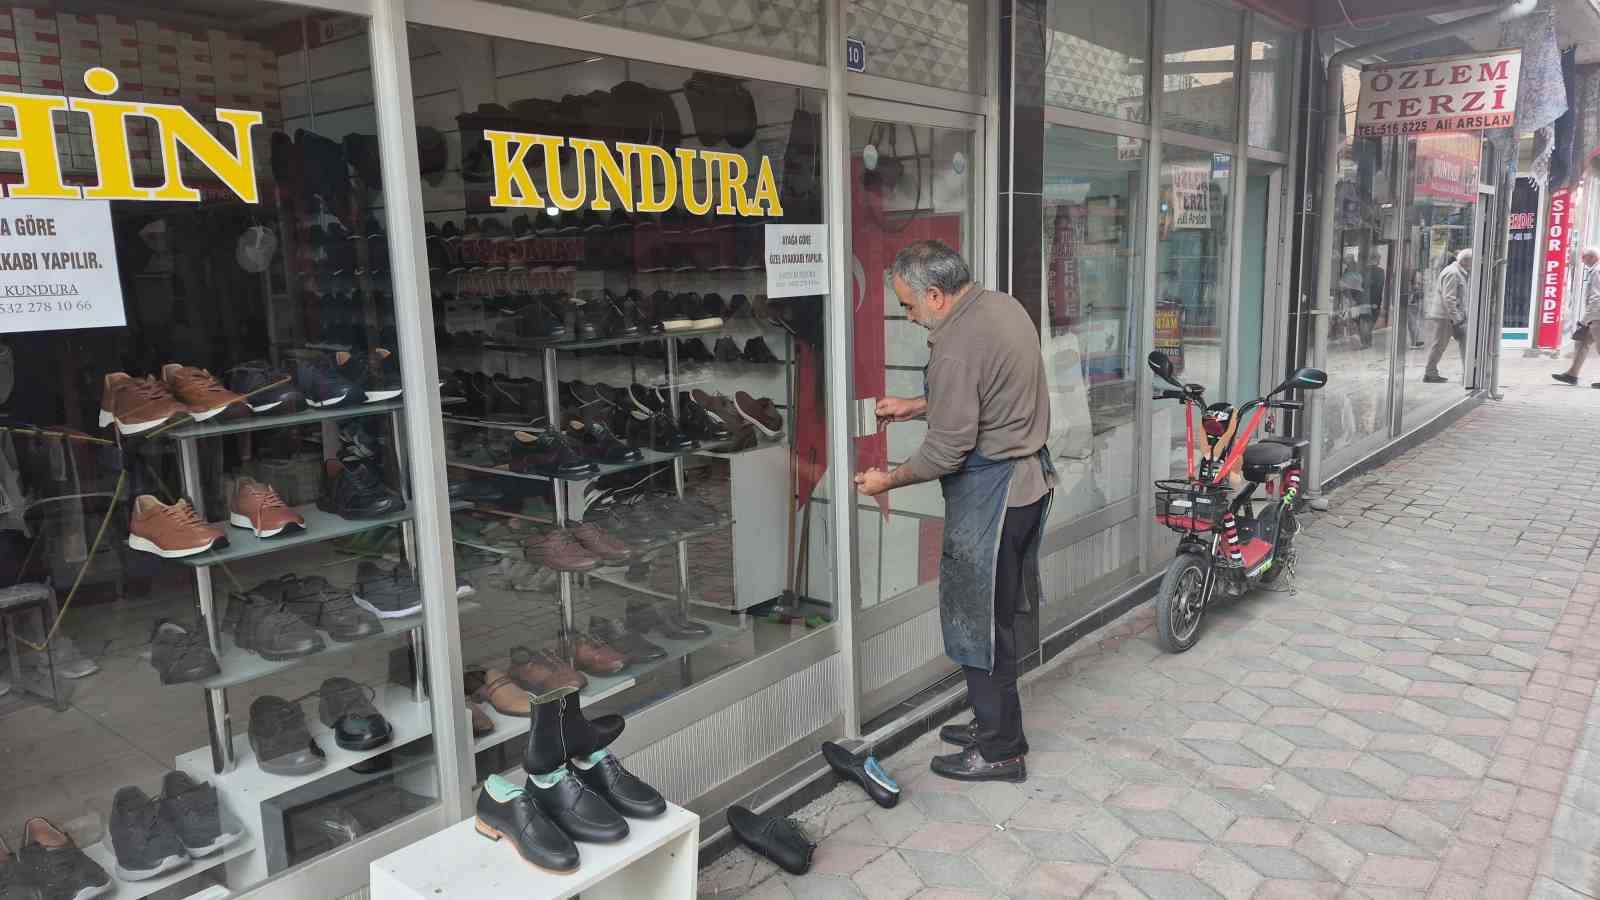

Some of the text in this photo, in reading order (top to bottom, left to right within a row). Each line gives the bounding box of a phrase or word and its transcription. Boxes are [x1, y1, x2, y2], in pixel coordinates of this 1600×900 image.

[849, 47, 859, 63] 10
[1371, 60, 1510, 92] ÖZLEM
[1368, 85, 1507, 120] TERZİ
[1457, 115, 1511, 129] ARSLAN
[484, 129, 783, 216] KUNDURA
[15, 214, 56, 236] GÖRE
[41, 251, 103, 270] YAPILIR.
[1543, 199, 1564, 324] STOR PERDE
[4, 284, 80, 297] KUNDURA
[28, 302, 52, 313] 278
[55, 301, 73, 312] 10
[76, 301, 92, 311] 66
